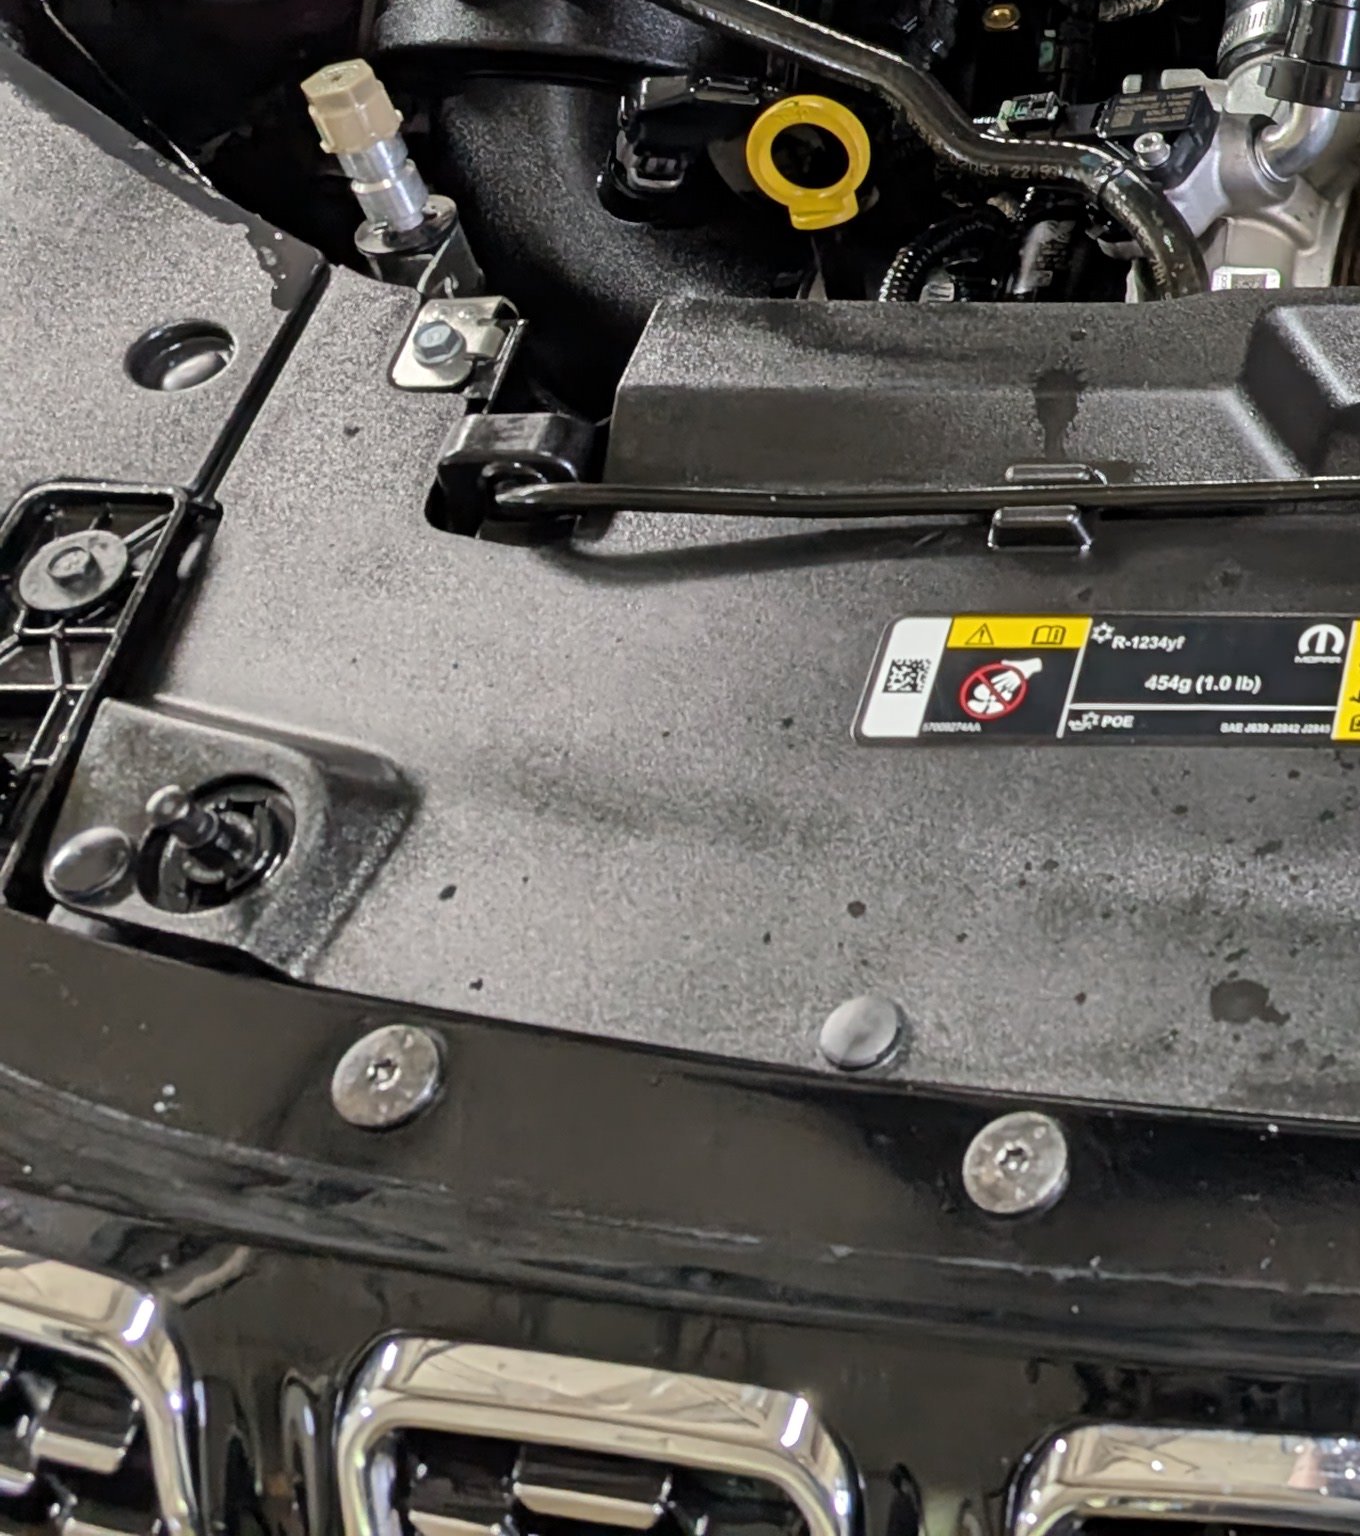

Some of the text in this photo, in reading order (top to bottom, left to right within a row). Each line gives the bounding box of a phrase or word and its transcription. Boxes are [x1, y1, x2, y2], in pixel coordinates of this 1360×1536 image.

[1111, 635, 1186, 652] R-1234yf
[1144, 674, 1262, 695] 454g (1.0 lb)
[1101, 714, 1135, 728] POE
[1220, 722, 1244, 734] SAE
